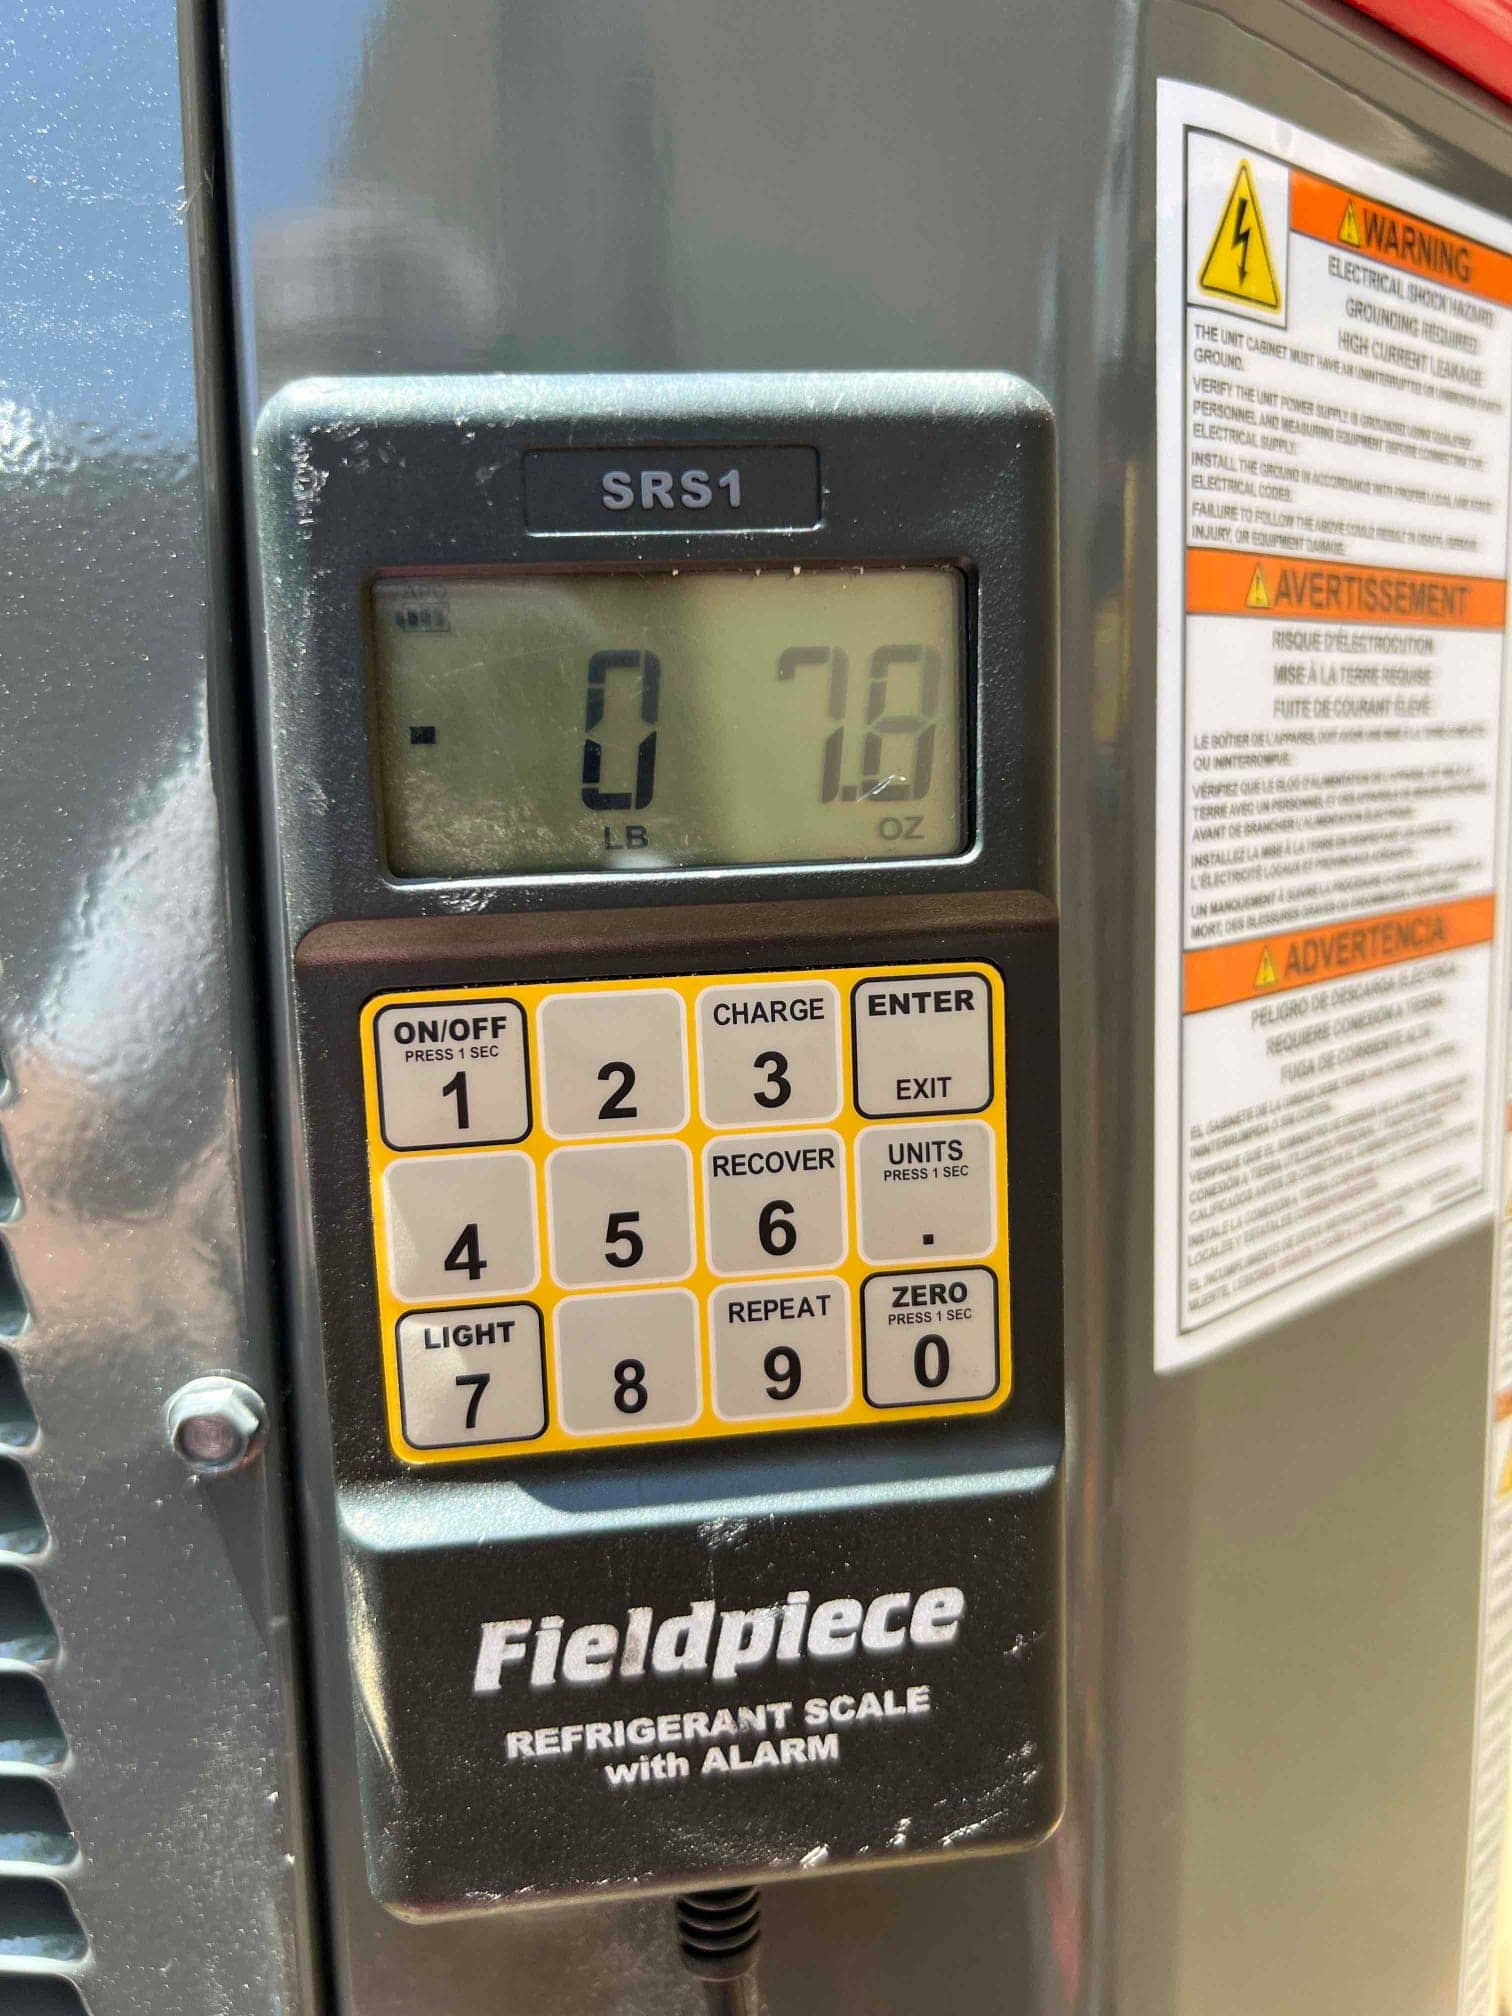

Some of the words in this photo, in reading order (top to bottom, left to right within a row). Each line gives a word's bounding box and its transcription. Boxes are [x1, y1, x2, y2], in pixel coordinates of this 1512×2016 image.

[1362, 207, 1472, 284] WARNING
[1328, 254, 1403, 299] ELECTRICAL
[1409, 278, 1446, 311] SHOCK
[1345, 297, 1419, 338] GROUNDING
[1194, 324, 1218, 342] THE
[1221, 329, 1244, 347] UNIT
[1246, 336, 1287, 359] CABINET
[1289, 347, 1314, 367] MUST
[1317, 354, 1339, 374] HAVE
[1194, 347, 1244, 371] GROUND.
[1339, 330, 1368, 354] HIGH
[1371, 339, 1427, 373] CURRENT
[1192, 377, 1233, 397] VERIFY
[1236, 384, 1256, 402] THE
[1257, 388, 1279, 407] UNIT
[1280, 395, 1314, 416] POWER
[1192, 400, 1257, 426] PERSONNEL
[1259, 412, 1280, 430] AND
[1193, 423, 1257, 448] ELECTRICAL
[1192, 452, 1236, 472] INSTALL
[1238, 458, 1257, 476] THE
[1260, 462, 1299, 483] GROUND
[603, 469, 740, 508] SRS1
[1192, 474, 1257, 498] ELECTRICAL
[1192, 502, 1238, 521] FAILURE
[1239, 507, 1253, 521] TO
[1255, 508, 1295, 528] FOLLOW
[1295, 515, 1314, 531] THE
[1235, 529, 1249, 543] OR
[1275, 569, 1469, 617] AVERTISSEMENT
[1272, 629, 1322, 651] RISQUE
[1273, 665, 1303, 686] MISE
[1320, 665, 1337, 685] LA
[1273, 698, 1313, 719] FUITE
[1315, 699, 1332, 719] DE
[1333, 697, 1391, 718] COURANT
[581, 650, 661, 810] 0
[778, 644, 943, 805] 7.8
[1193, 735, 1209, 750] LE
[1193, 755, 1210, 771] OU
[604, 825, 648, 850] LB
[880, 817, 925, 841] OZ
[1284, 917, 1446, 977] ADVERTENCIA
[714, 998, 824, 1025] CHARGE
[869, 990, 974, 1016] ENTER
[1251, 1001, 1309, 1029] PELIGRO
[1312, 992, 1329, 1012] DE
[394, 1016, 506, 1044] ON/OFF
[1266, 1022, 1331, 1056] REQUIERE
[406, 1049, 453, 1062] PRESS
[459, 1048, 464, 1059] 1
[471, 1045, 498, 1058] SEC
[598, 1062, 637, 1119] 2
[754, 1052, 791, 1108] 3
[897, 1077, 951, 1100] EXIT
[443, 1072, 469, 1129] 1
[713, 1148, 834, 1177] RECOVER
[889, 1140, 966, 1167] UNITS
[884, 1168, 928, 1181] PRESS
[934, 1168, 937, 1177] 1
[944, 1165, 968, 1177] SEC
[606, 1212, 643, 1268] 5
[759, 1200, 796, 1256] 6
[445, 1224, 487, 1280] 4
[729, 1295, 830, 1323] REPEAT
[892, 1282, 970, 1311] ZERO
[889, 1312, 931, 1325] PRESS
[937, 1312, 941, 1321] 1
[947, 1308, 971, 1320] SEC
[425, 1321, 515, 1349] LIGHT
[764, 1346, 801, 1400] 9
[914, 1334, 949, 1388] 0
[456, 1374, 490, 1429] 7
[615, 1359, 647, 1413] 8
[474, 1587, 964, 1695] Fieldpiece
[506, 1702, 794, 1758] REFRIGERANT
[805, 1685, 931, 1725] SCALE
[604, 1751, 689, 1785] with
[702, 1734, 839, 1774] ALARM
